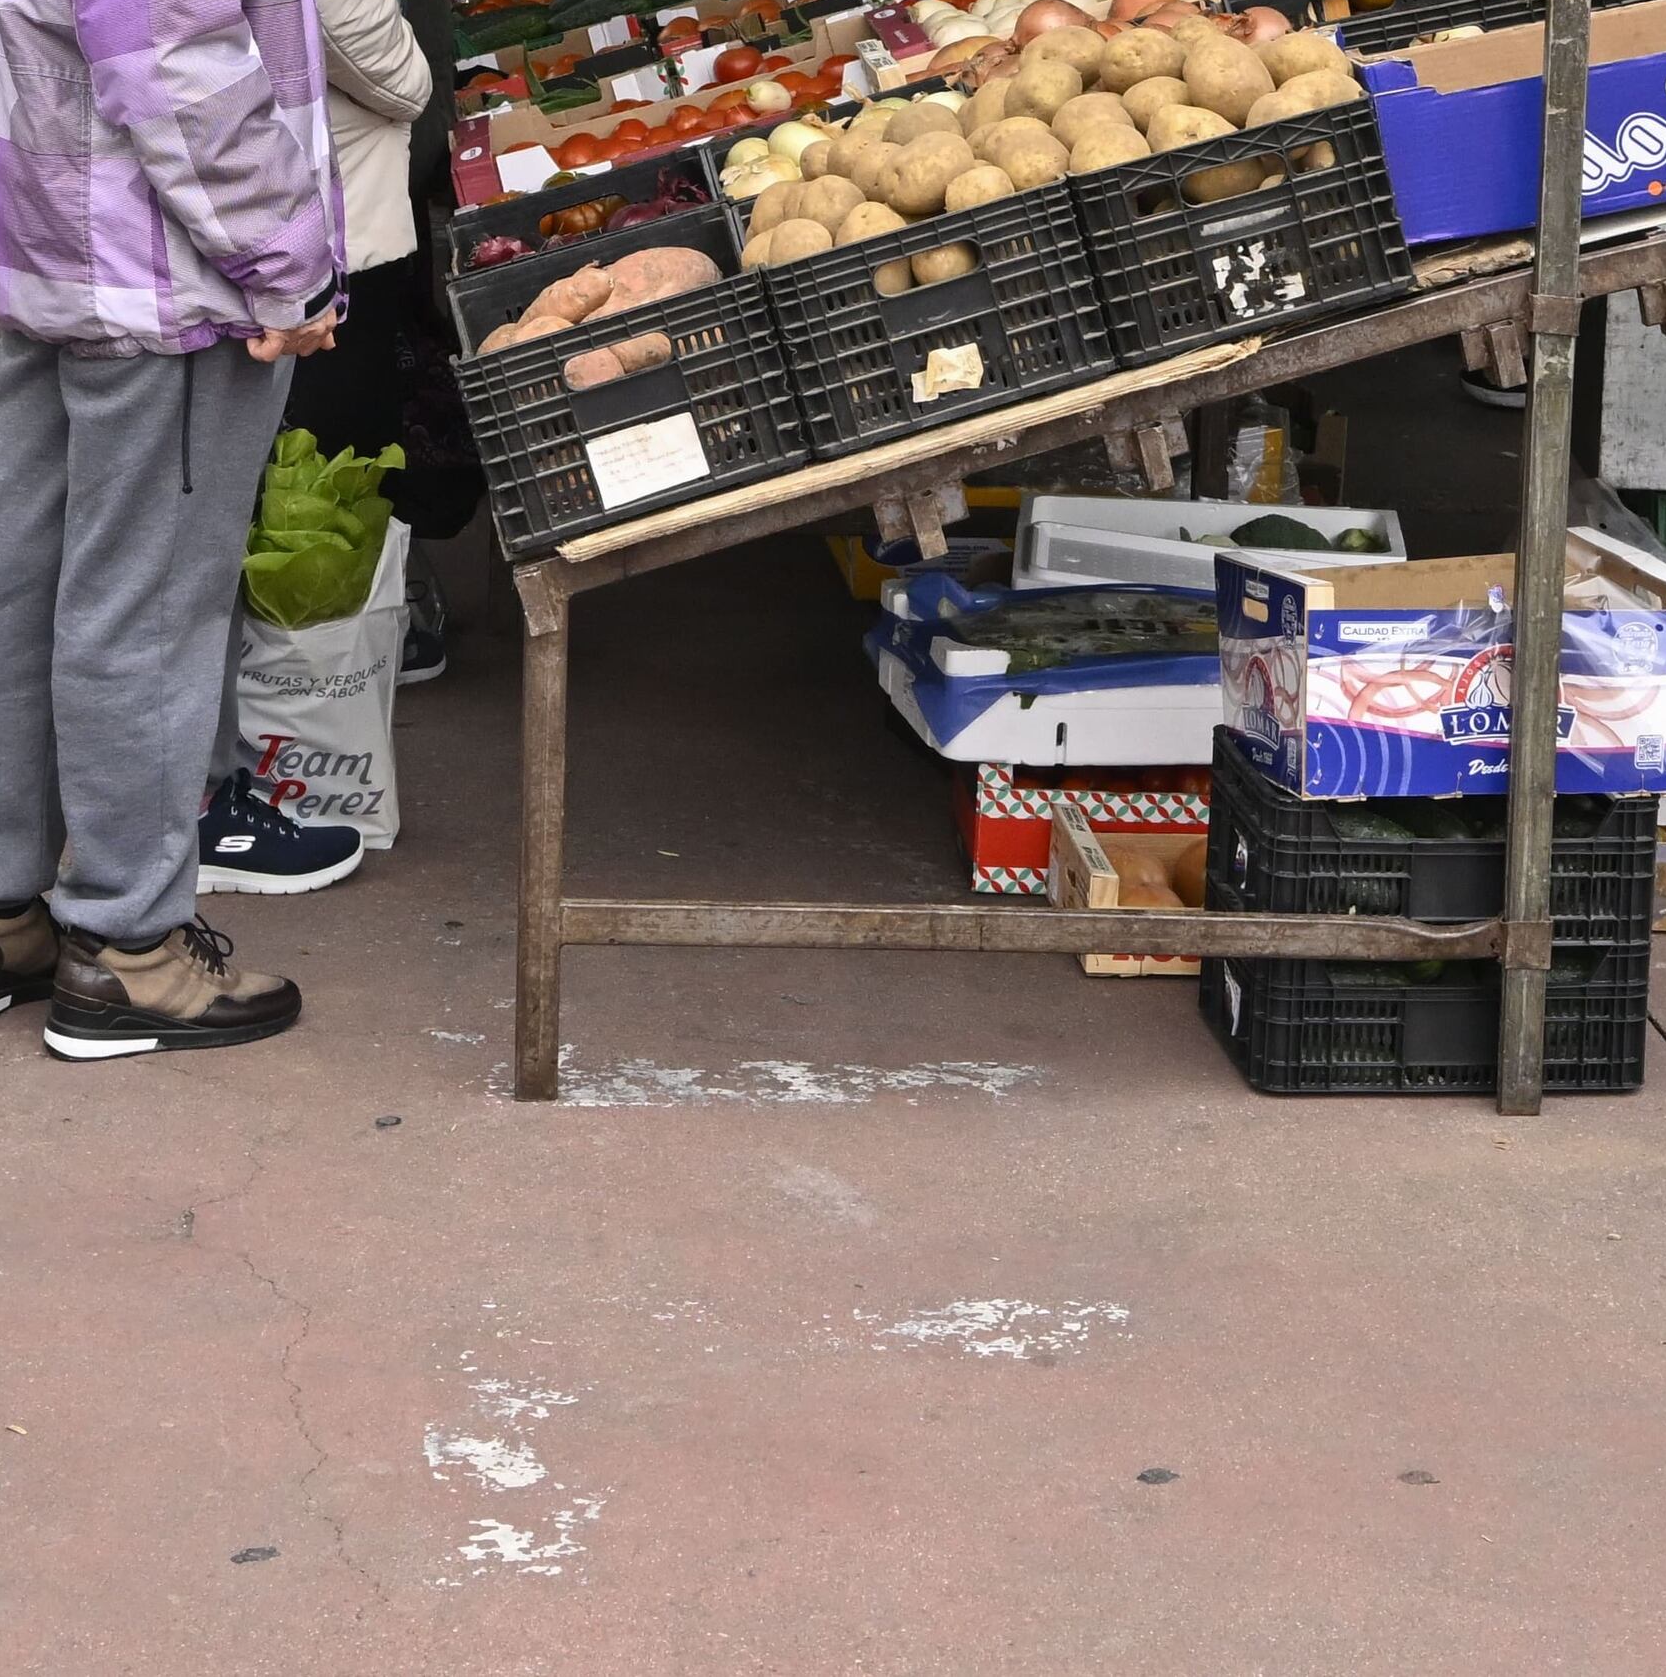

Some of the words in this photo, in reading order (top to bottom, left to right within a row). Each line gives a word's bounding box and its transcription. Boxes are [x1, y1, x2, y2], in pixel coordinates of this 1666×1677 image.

[241, 670, 303, 688] FRUTAS
[309, 677, 322, 688] Y
[325, 655, 388, 687] VERDURAS
[277, 688, 313, 697] CON
[316, 682, 367, 700] SABOR
[1244, 709, 1279, 743] LOMAR
[254, 734, 374, 787] Team
[268, 779, 386, 820] Perez
